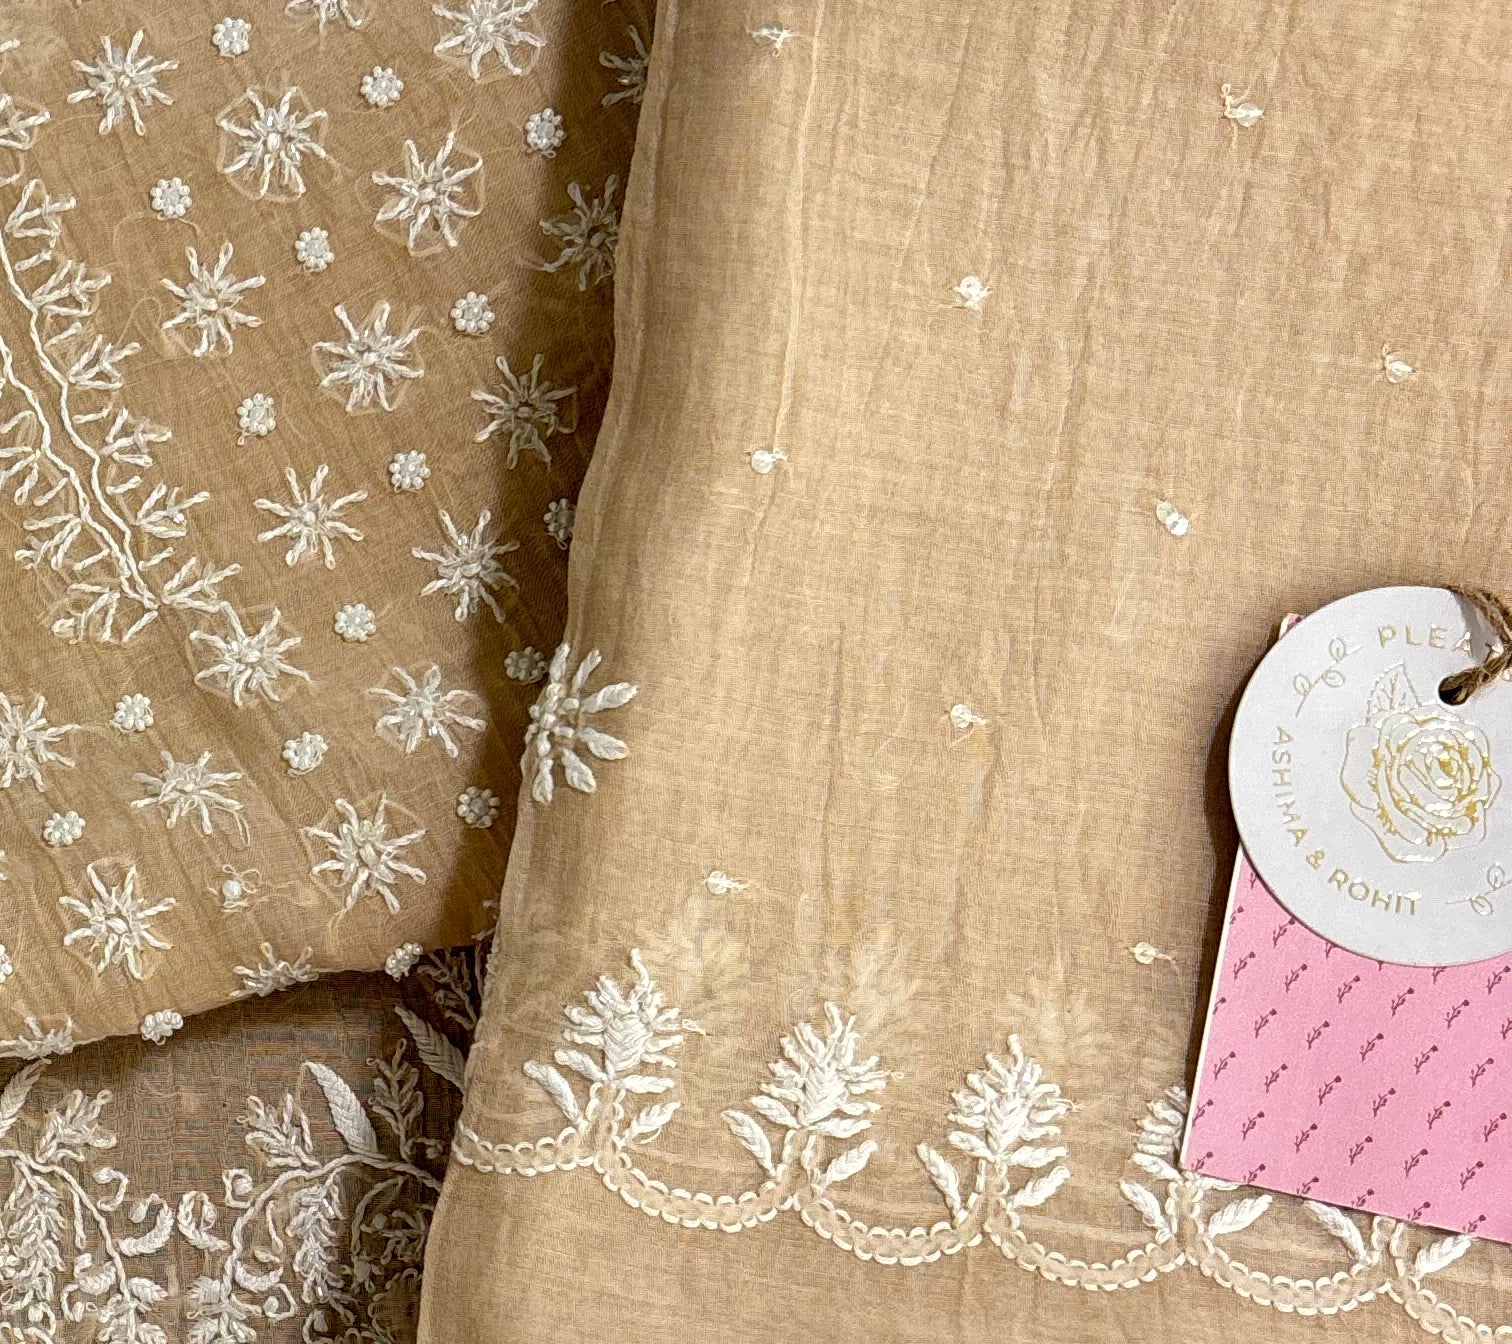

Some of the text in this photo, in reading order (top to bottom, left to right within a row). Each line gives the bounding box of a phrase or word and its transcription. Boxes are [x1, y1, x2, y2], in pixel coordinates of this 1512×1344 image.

[1272, 726, 1422, 916] ASHIMA & ROHIT
